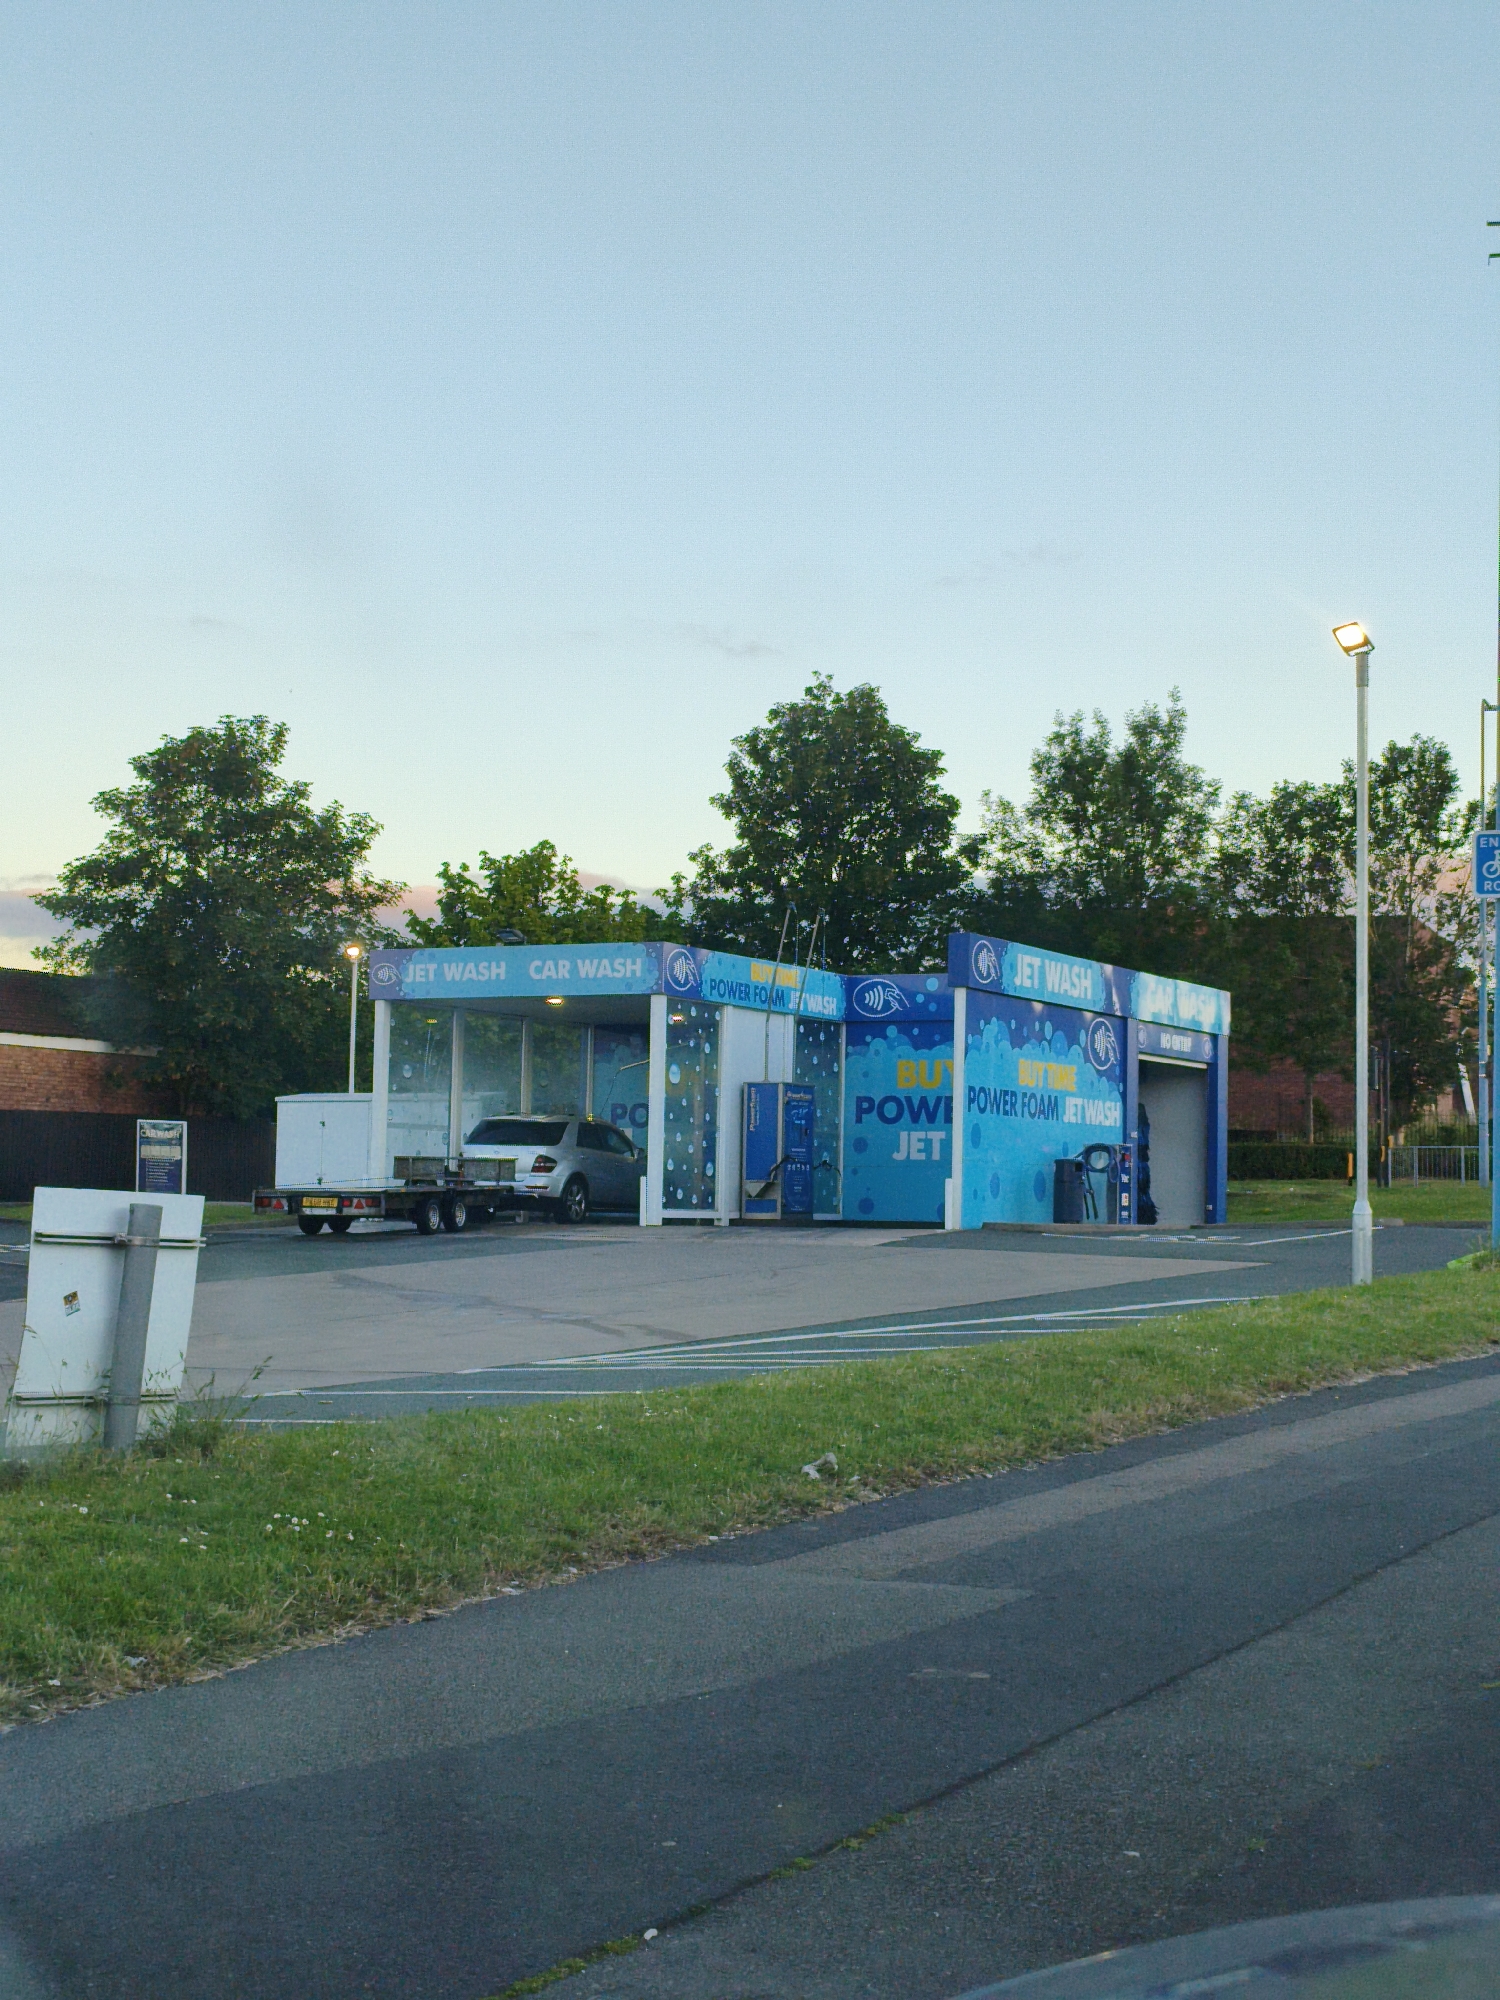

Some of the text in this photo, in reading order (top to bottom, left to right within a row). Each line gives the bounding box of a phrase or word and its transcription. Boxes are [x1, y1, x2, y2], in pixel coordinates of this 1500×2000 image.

[405, 961, 506, 983] JET WASH
[529, 957, 643, 980] CAR WASH
[751, 962, 773, 983] BUY
[1013, 953, 1092, 999] JET WASH
[709, 978, 751, 1003] POWER
[805, 993, 837, 1016] WASH
[1018, 1059, 1077, 1093] BUY TIME
[967, 1084, 1121, 1128] POWER FOAM JET WASH
[892, 1131, 947, 1161] JET
